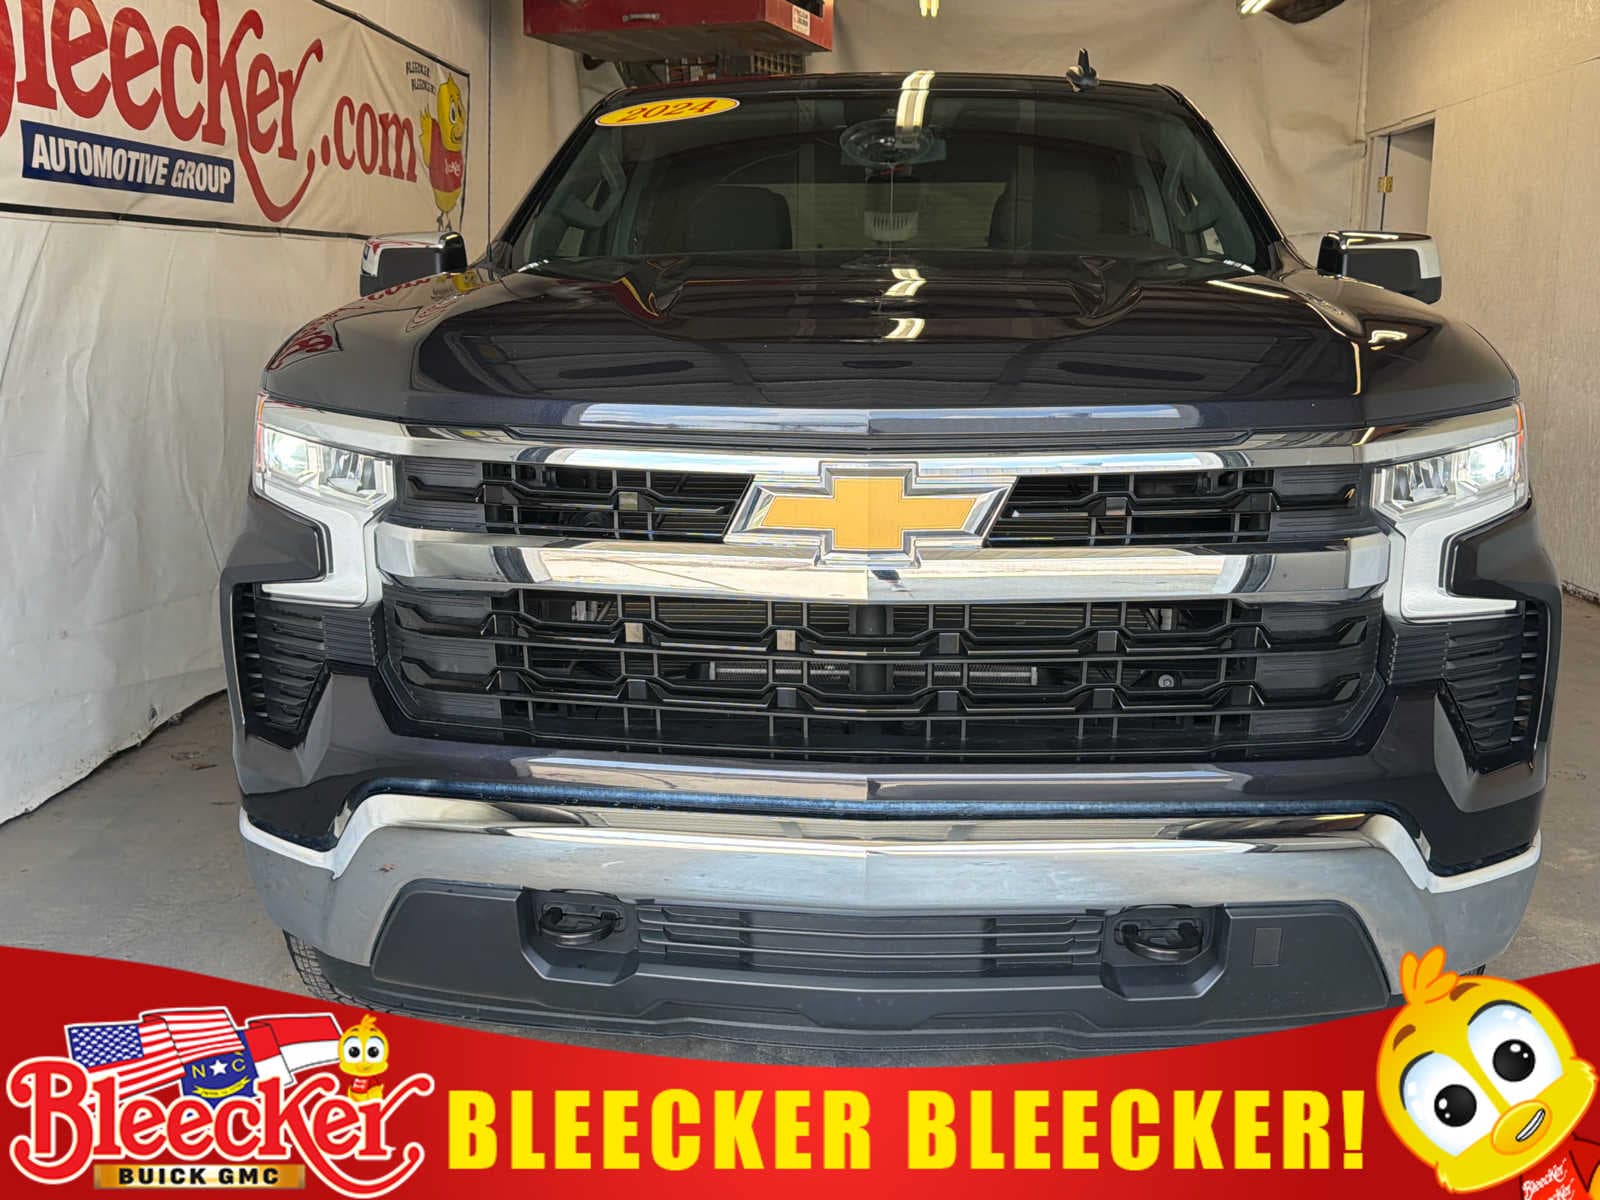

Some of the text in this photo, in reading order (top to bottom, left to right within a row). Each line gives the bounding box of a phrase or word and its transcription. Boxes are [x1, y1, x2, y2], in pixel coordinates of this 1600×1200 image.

[616, 100, 717, 122] 2024
[31, 133, 232, 195] AUTOMOTIVE GROUP
